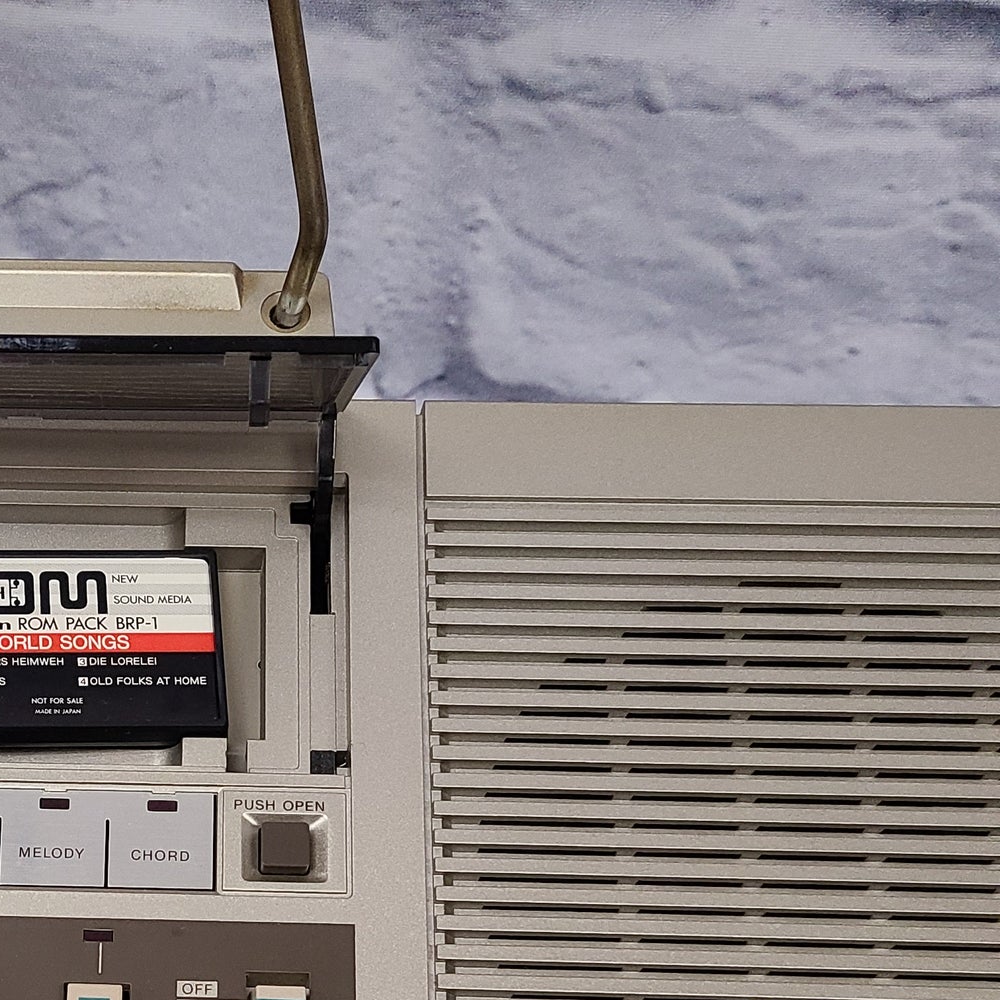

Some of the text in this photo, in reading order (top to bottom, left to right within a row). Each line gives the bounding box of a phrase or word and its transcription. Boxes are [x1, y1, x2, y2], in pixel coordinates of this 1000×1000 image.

[111, 574, 139, 584] NEW
[113, 594, 192, 605] SOUND MEDIA
[18, 616, 59, 631] ROM
[65, 616, 108, 631] PACK
[115, 616, 158, 630] BRP-1
[59, 634, 130, 650] SONGS
[11, 656, 65, 666] HEIMWEH
[88, 656, 107, 666] DIE
[110, 656, 157, 666] LORELEI
[89, 676, 113, 686] OLD
[116, 676, 153, 686] FOLKS
[156, 676, 171, 686] AT
[174, 676, 207, 686] HOME
[31, 697, 84, 705] NOT FOR SALE
[233, 799, 325, 812] PUSH OPEN
[18, 846, 85, 859] MELODY
[131, 849, 190, 862] CHORD
[182, 983, 213, 995] OFF
